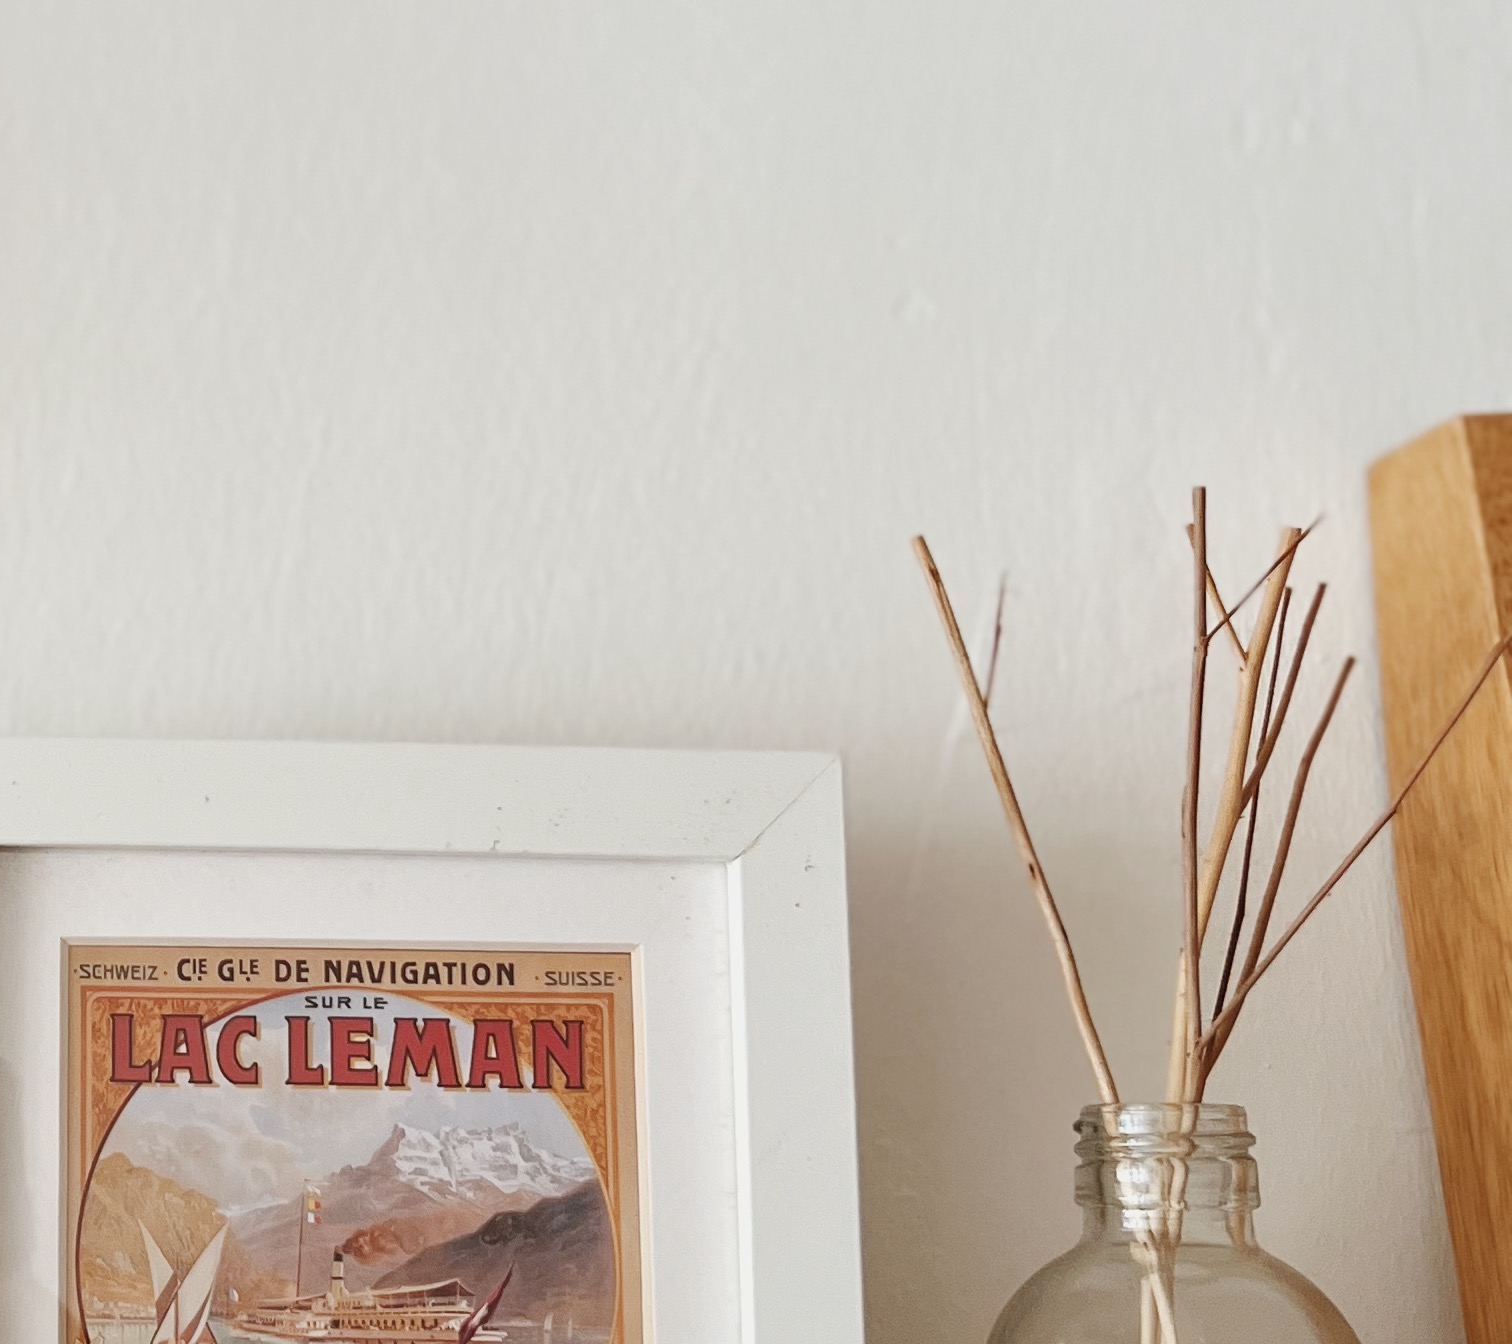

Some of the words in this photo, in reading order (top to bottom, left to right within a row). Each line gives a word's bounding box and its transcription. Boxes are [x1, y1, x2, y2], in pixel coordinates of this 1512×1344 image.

[79, 963, 159, 981] SCHWEIZ
[274, 959, 311, 984] DE
[324, 960, 516, 987] NAVIGATION
[544, 970, 616, 987] SUISSE
[304, 996, 353, 1010] SUR
[363, 996, 389, 1011] LE
[109, 1013, 260, 1087] LAC
[284, 1015, 587, 1090] LEMAN
